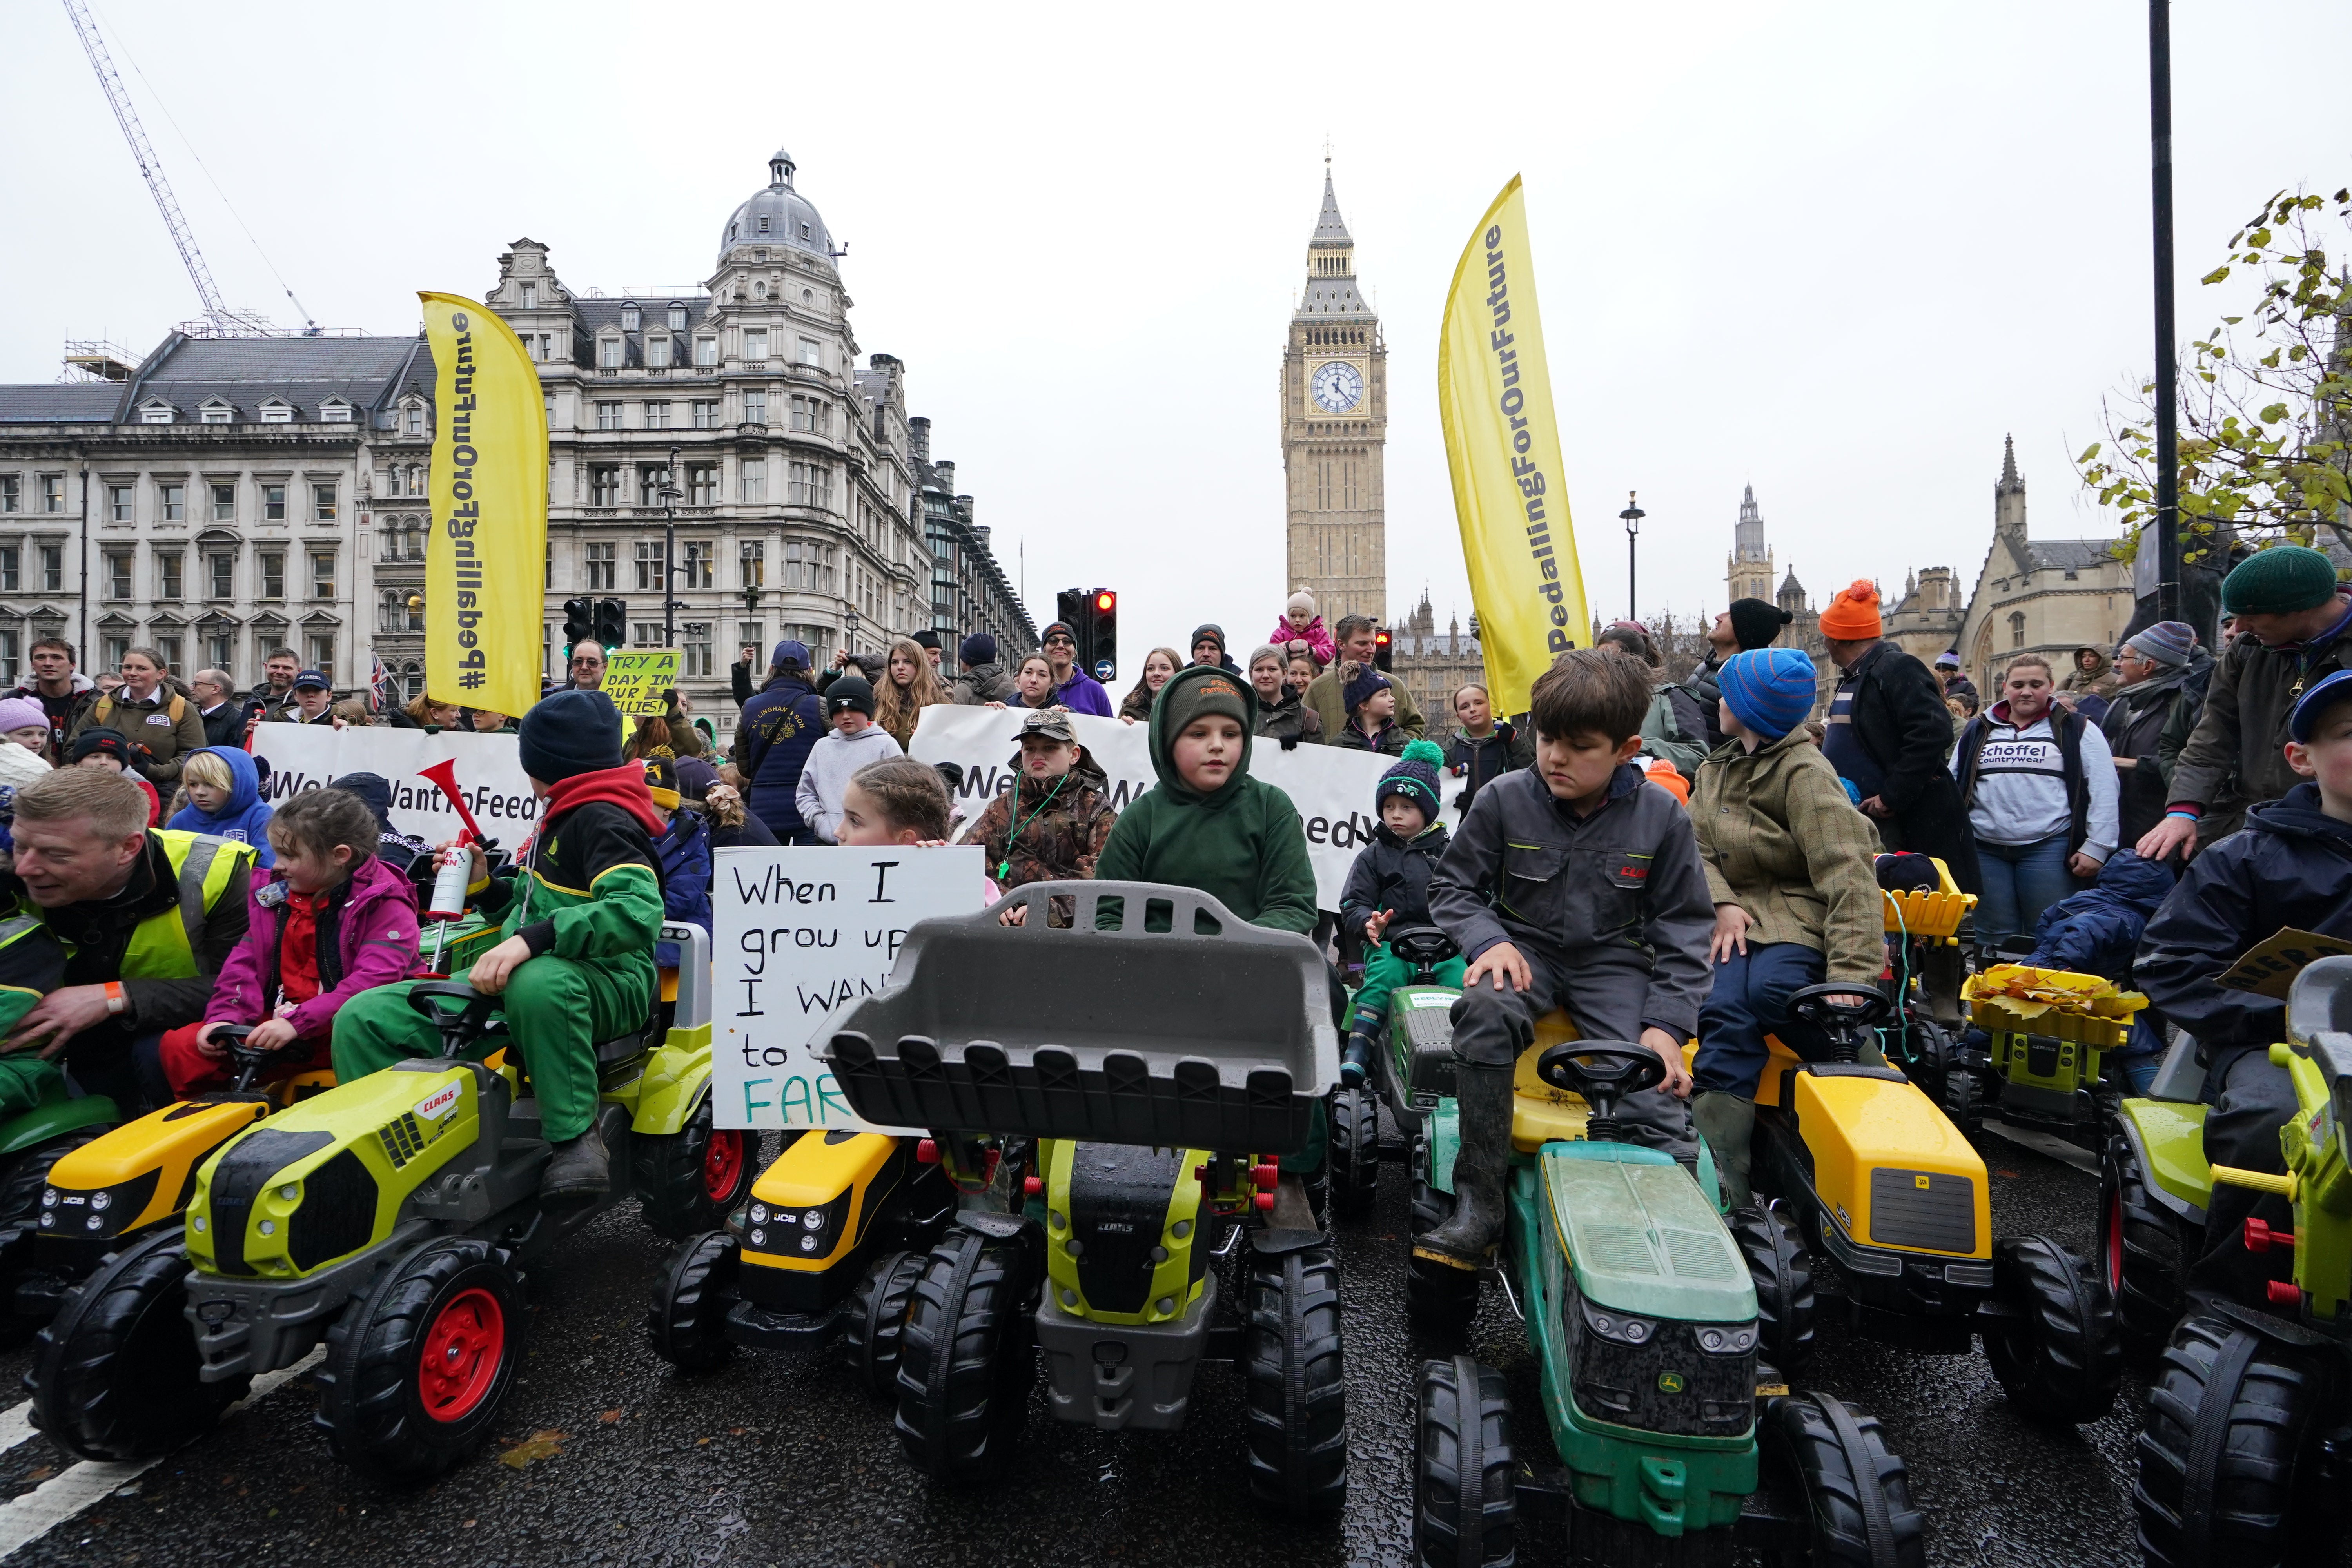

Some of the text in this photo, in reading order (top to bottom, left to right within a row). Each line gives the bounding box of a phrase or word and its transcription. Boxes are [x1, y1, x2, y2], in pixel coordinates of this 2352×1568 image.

[1485, 224, 1575, 662] PedallingForOurFuture
[613, 655, 673, 669] TRY A
[608, 674, 673, 685] DAY IN
[606, 688, 639, 698] OUR
[1200, 687, 1243, 703] FamilyFar
[613, 701, 664, 713] ELLIES!
[794, 714, 806, 729] SON
[733, 861, 900, 905] When I
[740, 928, 907, 975] grow up
[735, 973, 891, 1017] I WAN
[742, 1033, 788, 1067] to
[424, 1090, 454, 1113] CLAAS
[744, 1073, 852, 1124] FAR
[437, 1112, 457, 1132] ARION
[63, 1196, 85, 1205] JCB
[774, 1213, 796, 1223] JCB
[1837, 1203, 1851, 1228] JCB
